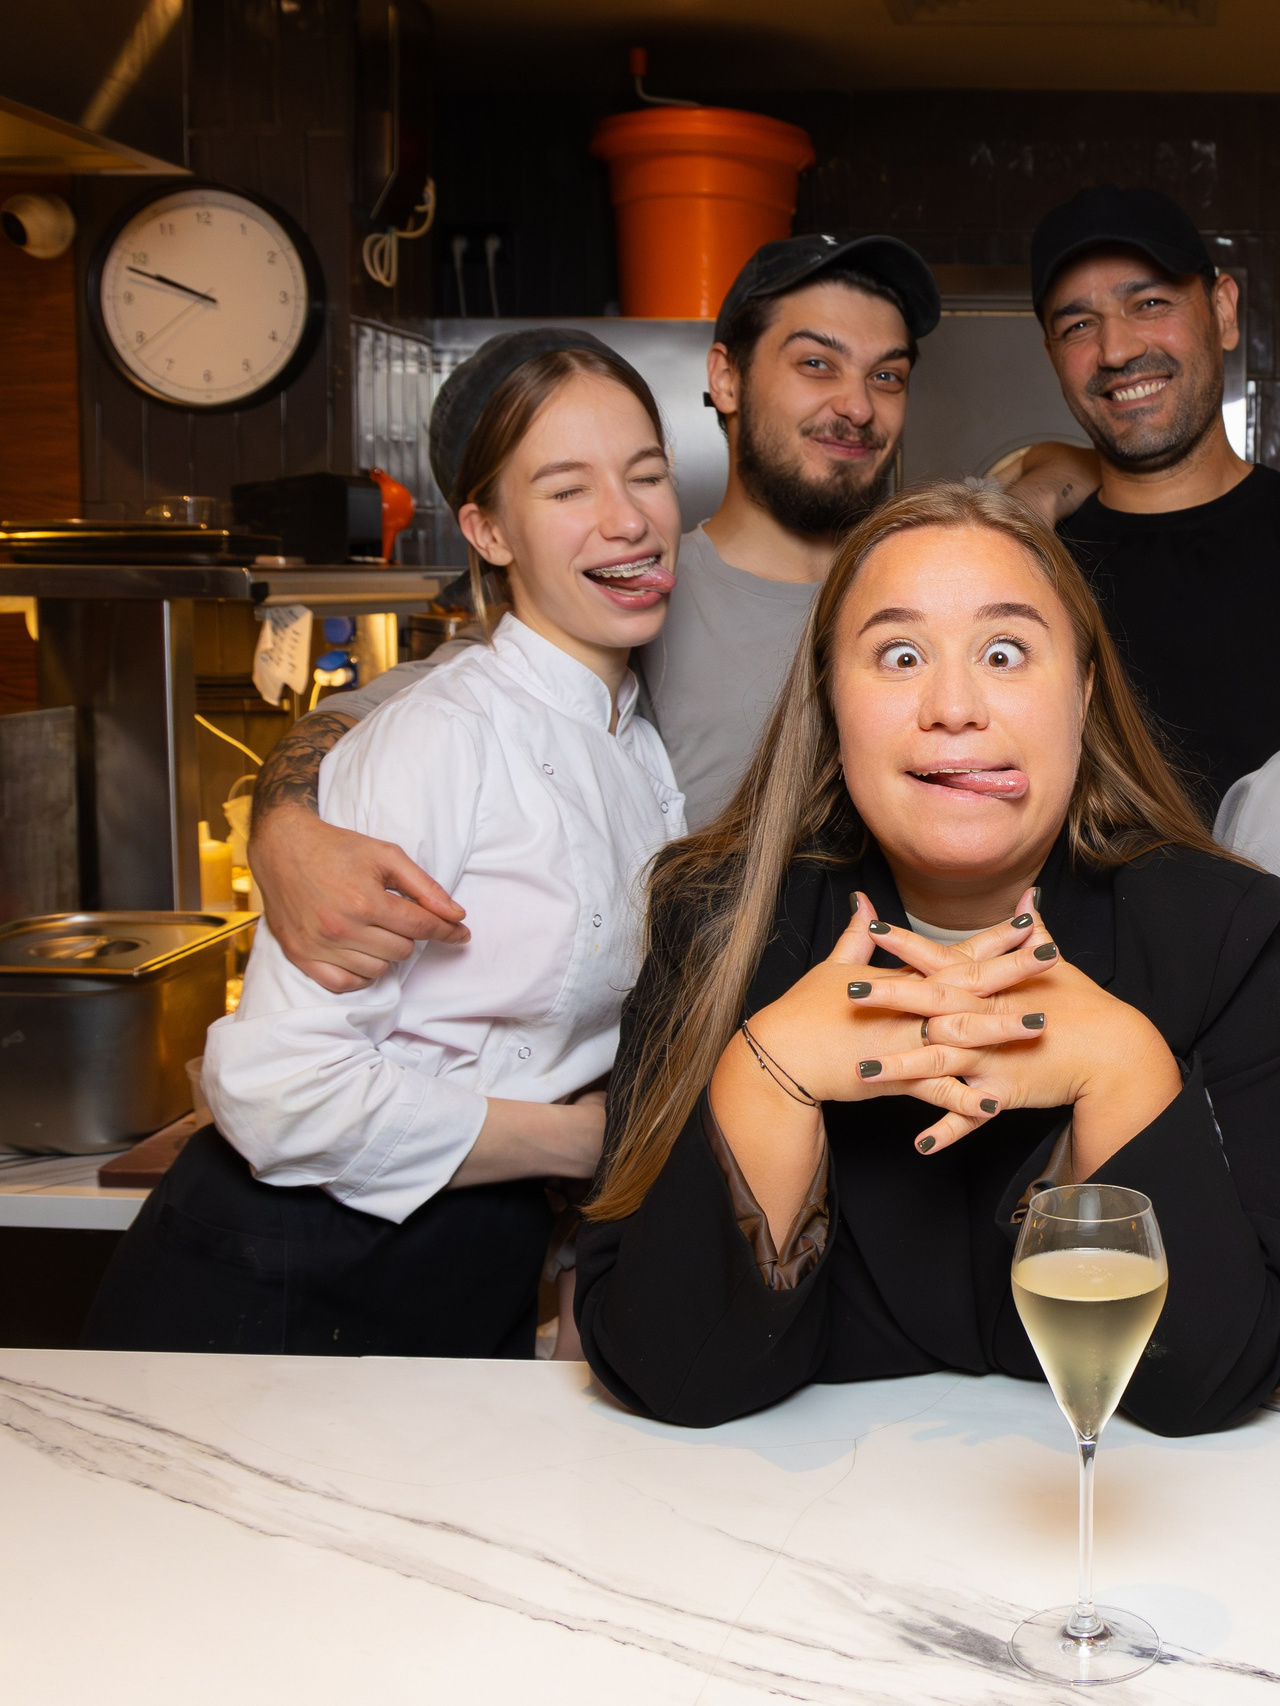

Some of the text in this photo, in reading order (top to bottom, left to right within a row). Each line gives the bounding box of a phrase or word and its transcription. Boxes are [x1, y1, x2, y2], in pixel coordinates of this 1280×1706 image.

[195, 211, 212, 225] 12
[159, 222, 175, 236] 11
[240, 222, 248, 236] 1
[131, 251, 148, 265] 10
[266, 250, 277, 264] 2
[123, 291, 133, 305] 9
[279, 291, 289, 305] 3
[135, 331, 146, 344] 8
[268, 329, 278, 342] 4
[165, 358, 175, 371] 7
[241, 358, 251, 372] 5
[202, 370, 212, 382] 6
